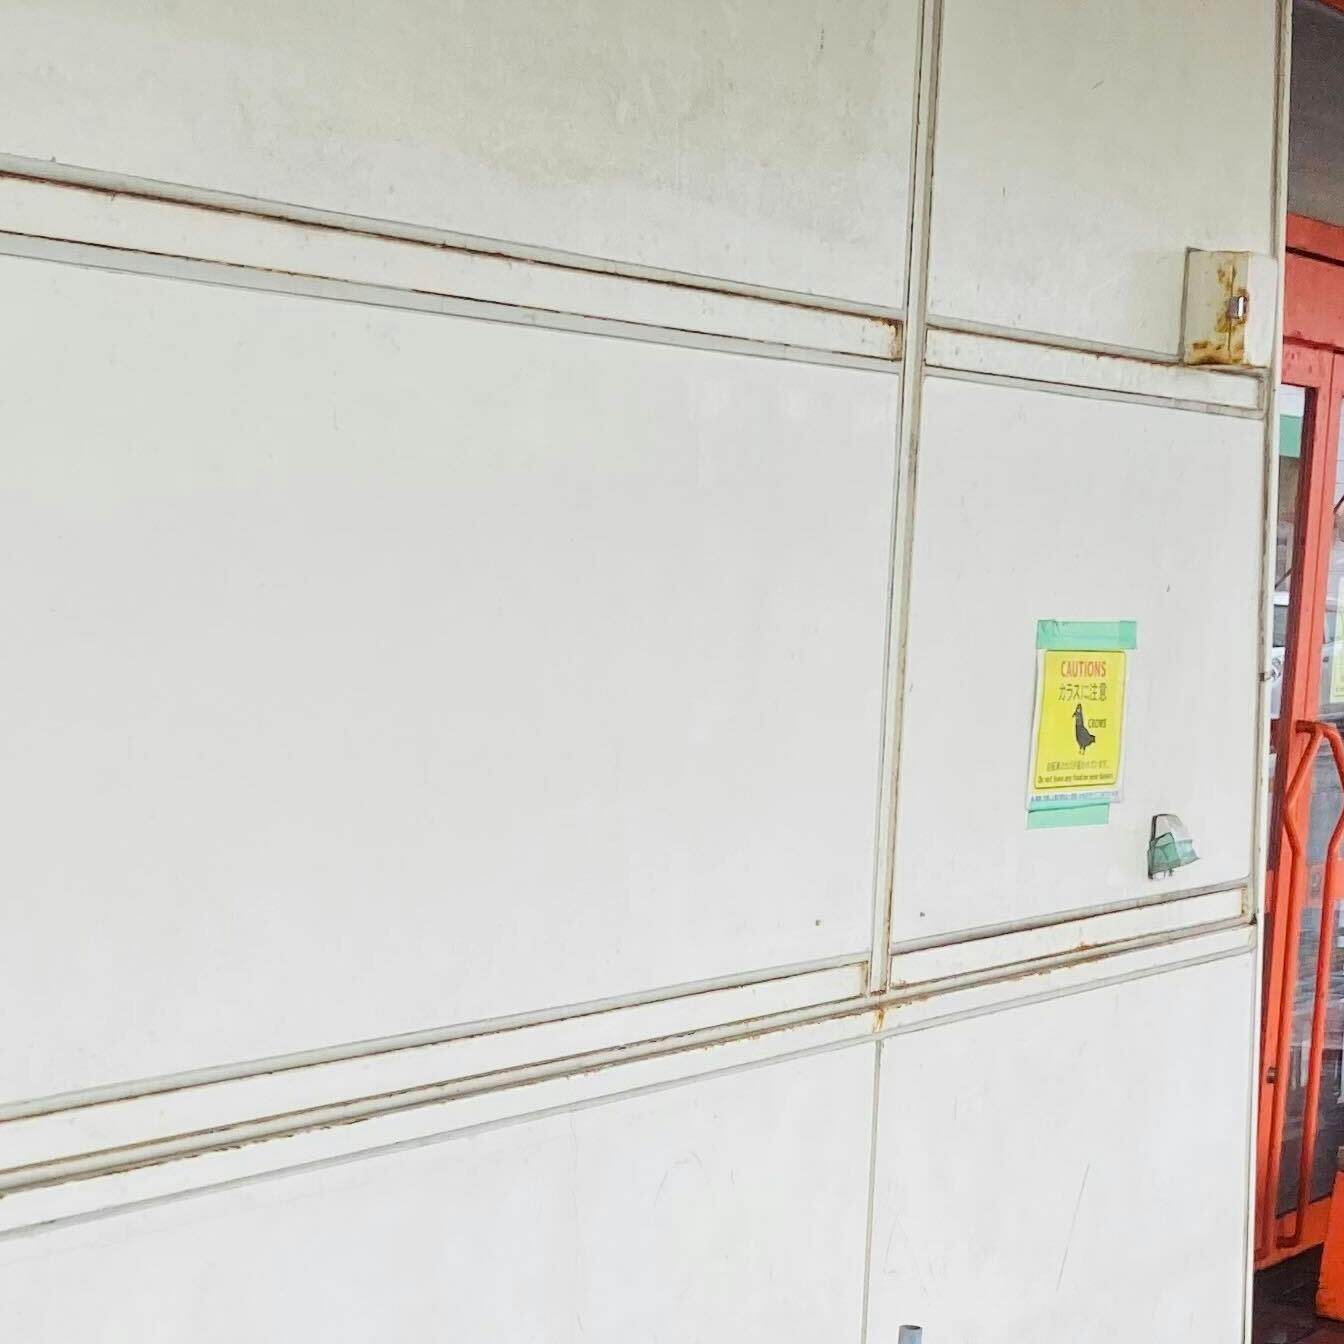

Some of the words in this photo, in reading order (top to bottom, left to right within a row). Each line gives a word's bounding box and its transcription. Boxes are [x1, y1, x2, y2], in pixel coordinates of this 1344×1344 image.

[1061, 661, 1106, 677] CAUTIONS
[1058, 682, 1107, 701] カラスに注意
